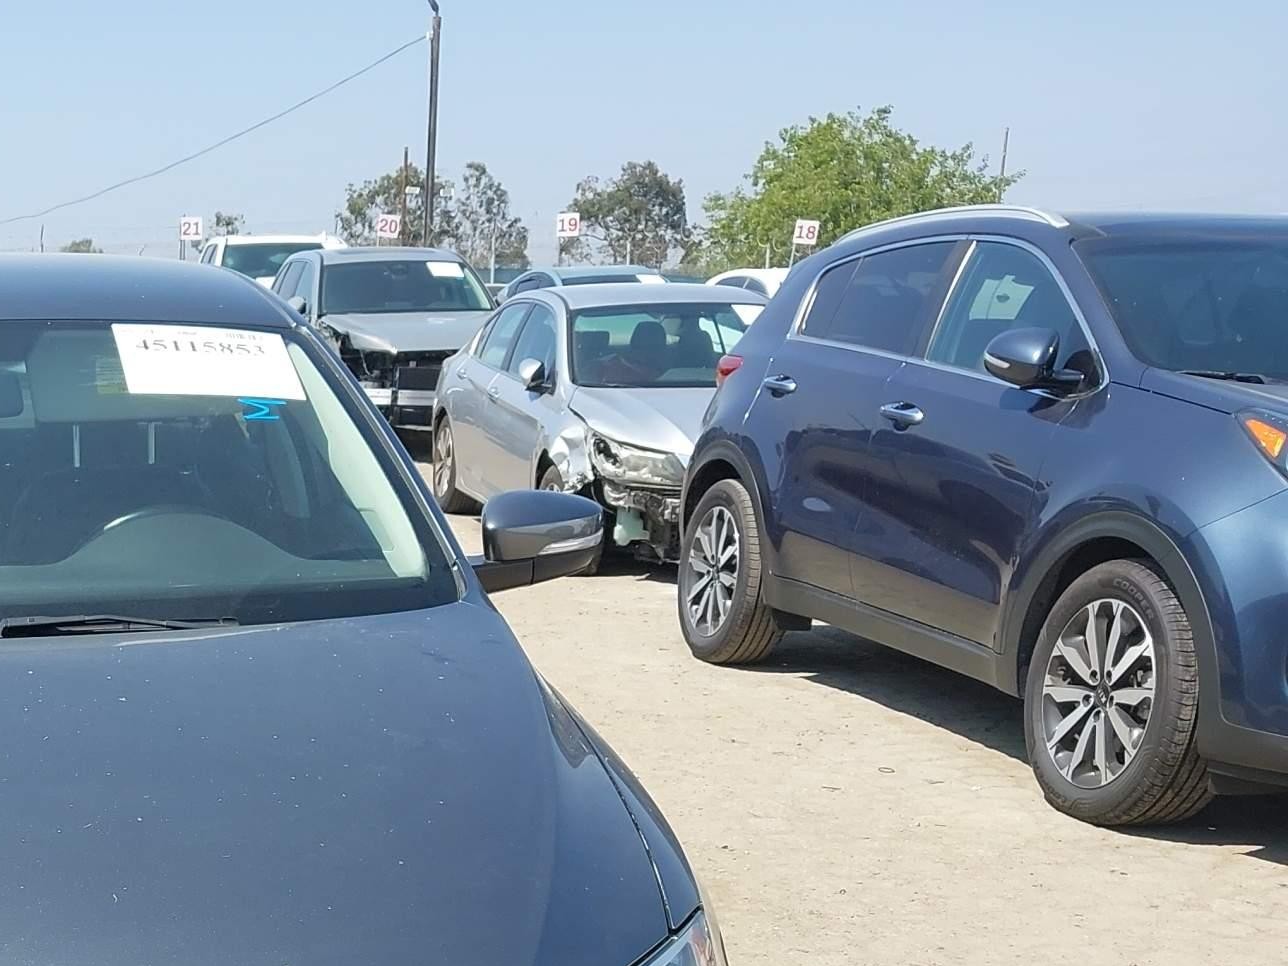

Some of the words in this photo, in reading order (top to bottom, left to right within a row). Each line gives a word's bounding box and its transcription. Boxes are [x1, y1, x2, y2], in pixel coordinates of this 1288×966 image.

[182, 221, 200, 236] 21
[379, 218, 398, 233] 20
[558, 217, 578, 232] 19
[795, 225, 816, 240] 18
